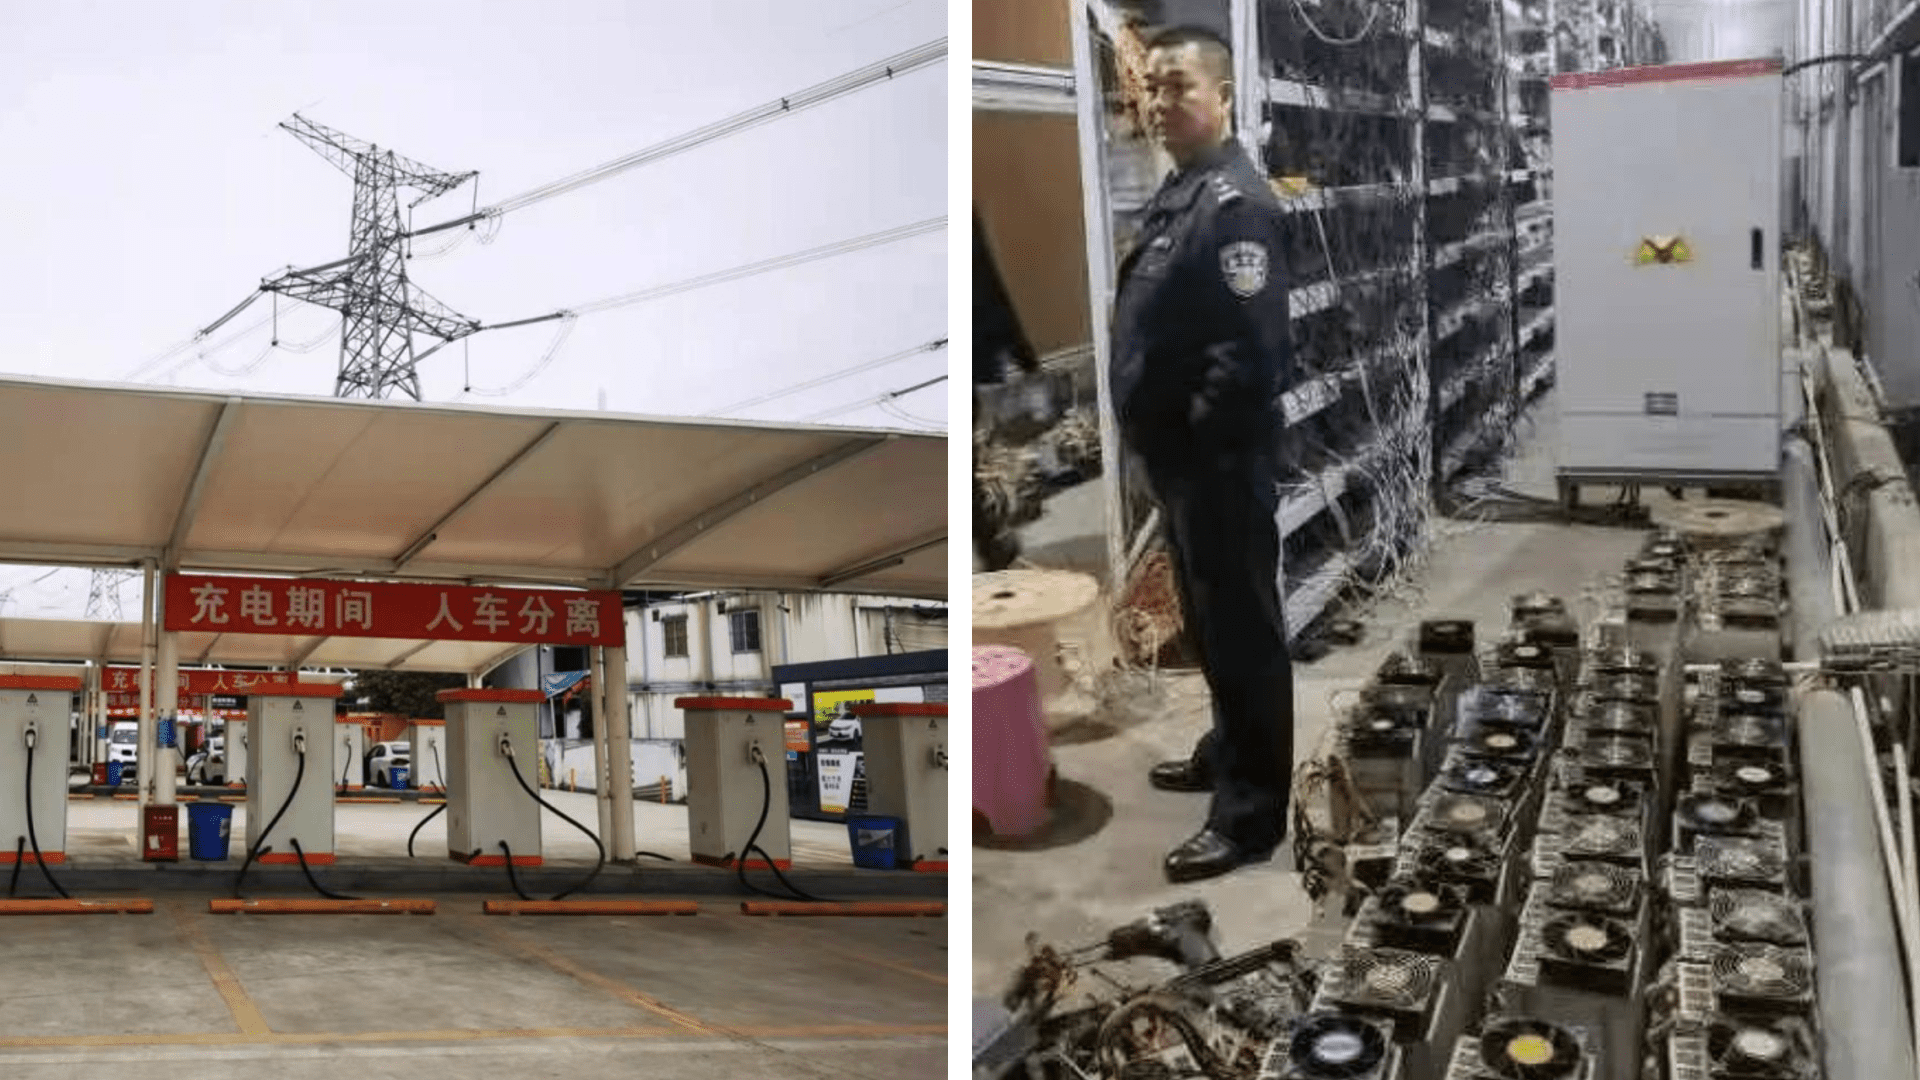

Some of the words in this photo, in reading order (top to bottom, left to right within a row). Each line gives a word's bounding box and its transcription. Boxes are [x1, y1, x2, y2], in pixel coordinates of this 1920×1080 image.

[190, 582, 373, 630] 充电期间
[426, 592, 600, 638] 人车分离
[112, 671, 190, 690] 充间
